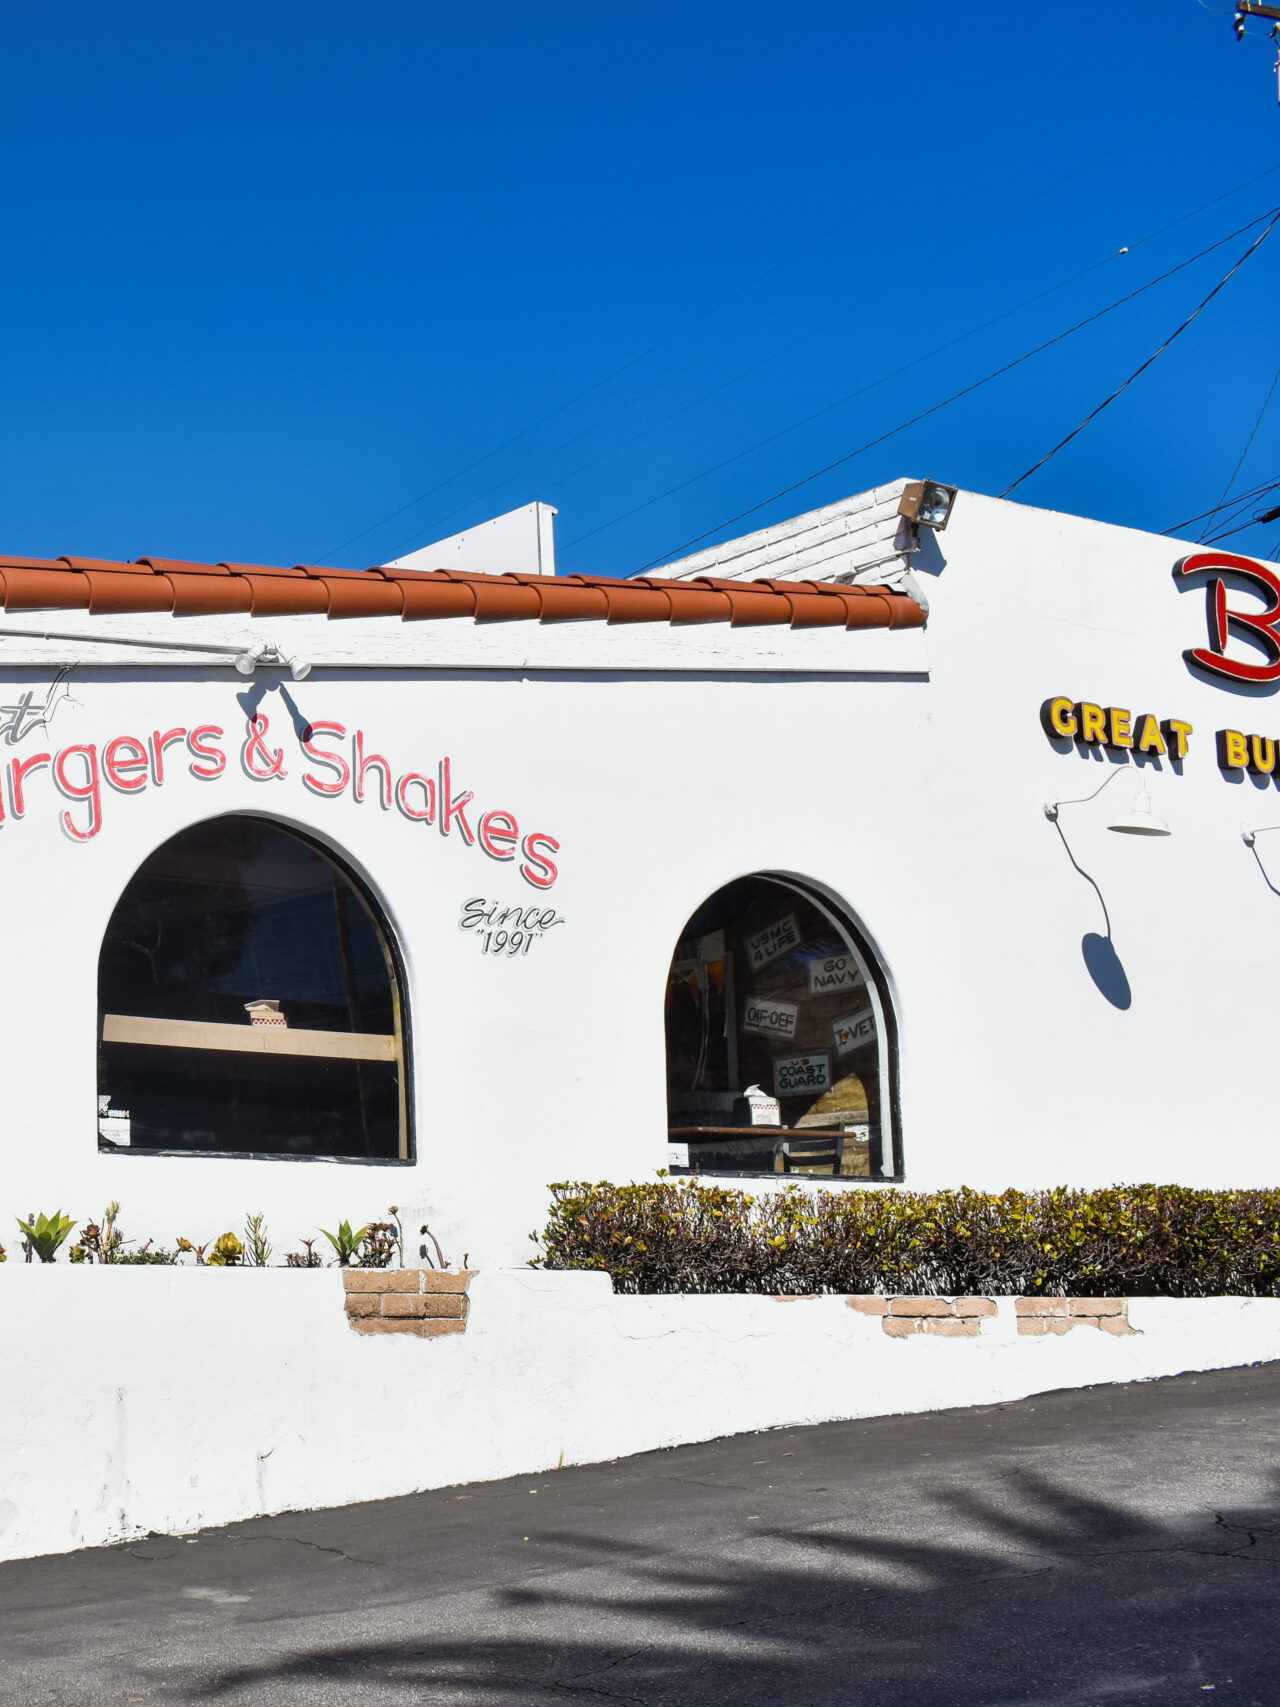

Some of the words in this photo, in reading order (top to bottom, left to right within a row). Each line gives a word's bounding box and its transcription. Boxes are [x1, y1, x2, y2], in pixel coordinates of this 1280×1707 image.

[1041, 696, 1193, 760] GREAT
[1216, 729, 1280, 778] BU
[241, 713, 288, 781] &
[300, 720, 560, 889] Shakes
[459, 897, 566, 931] Since
[750, 919, 793, 950] USMC
[753, 949, 764, 962] 4
[764, 930, 797, 957] LIFE
[814, 968, 859, 988] NAVY
[823, 958, 847, 973] GO
[778, 1063, 826, 1077] COAST
[778, 1074, 826, 1089] GUARD
